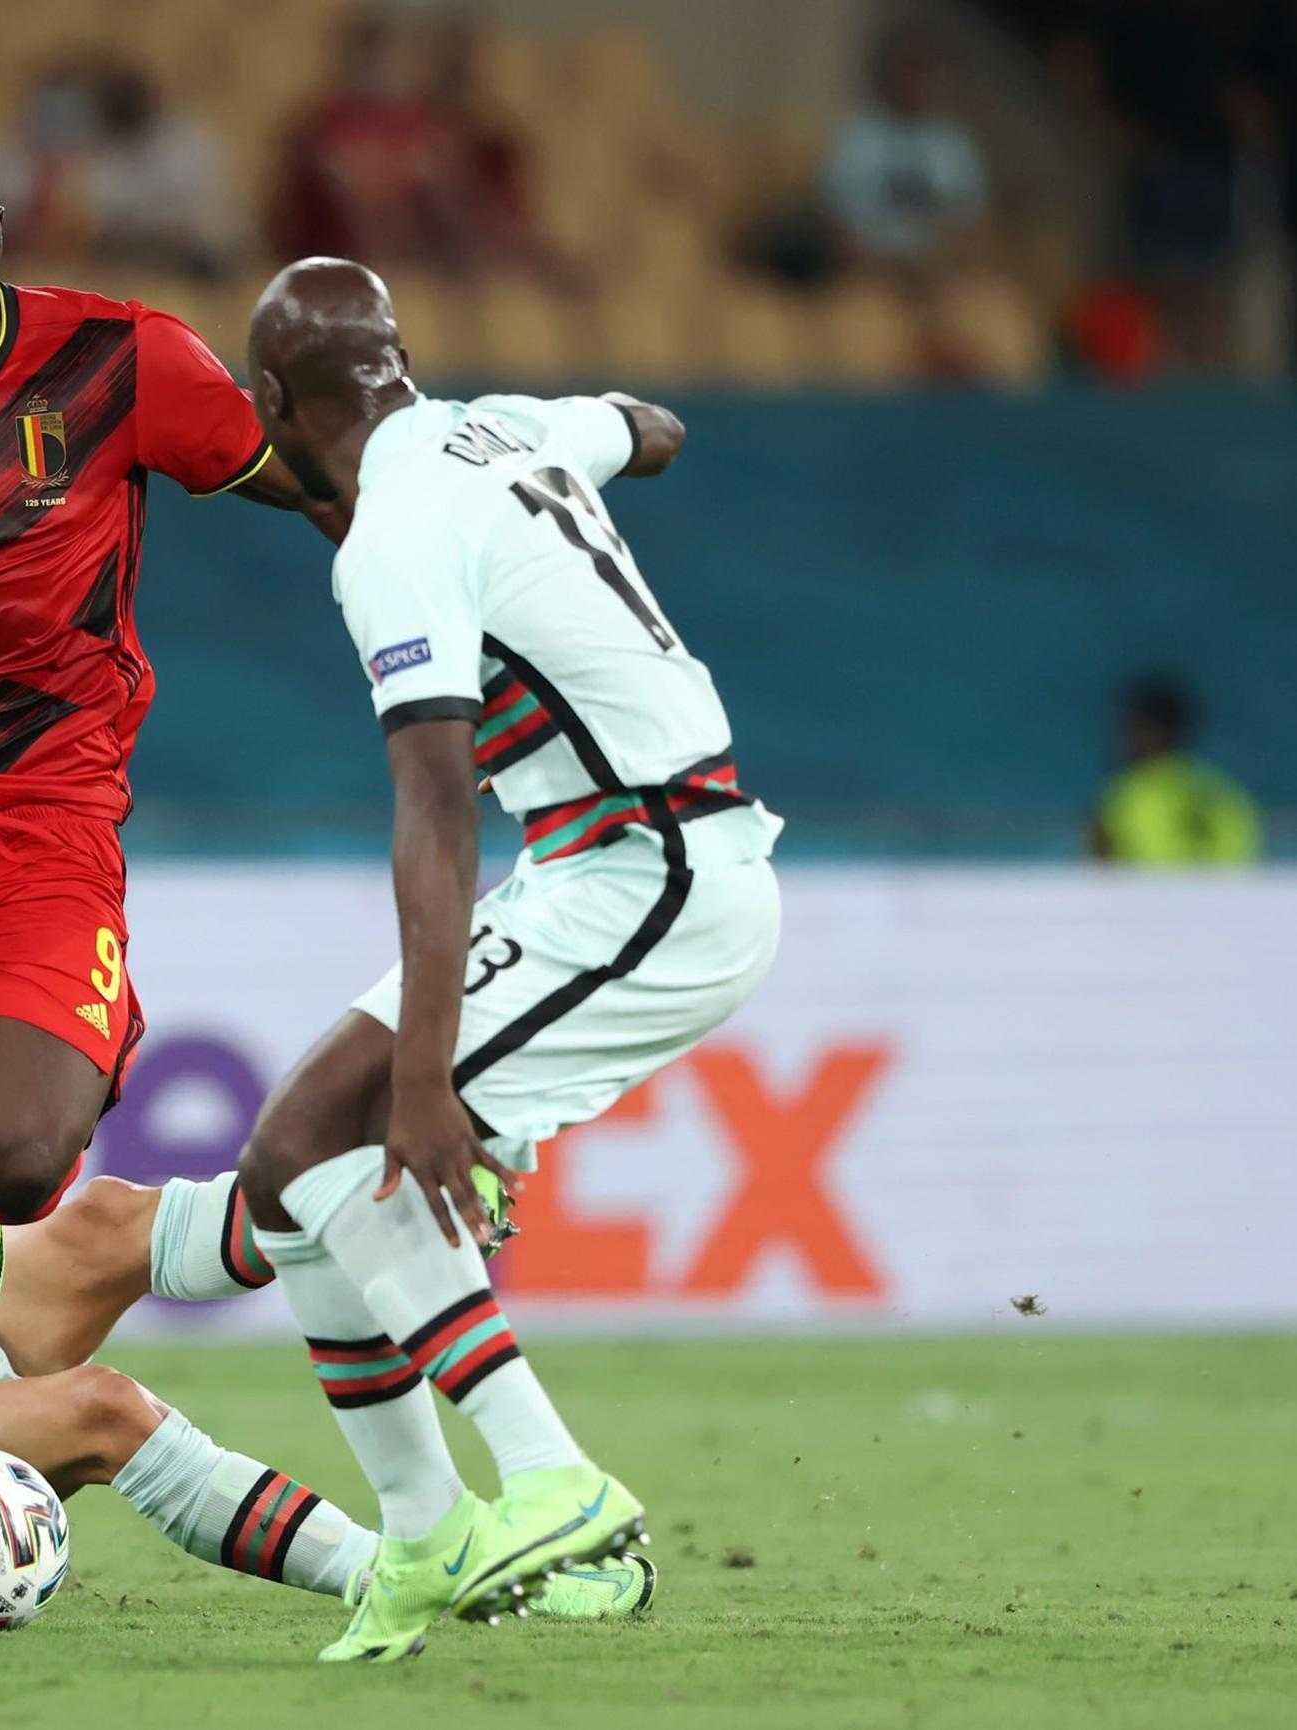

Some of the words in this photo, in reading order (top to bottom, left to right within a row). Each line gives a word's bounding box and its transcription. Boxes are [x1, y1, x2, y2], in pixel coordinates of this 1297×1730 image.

[25, 498, 39, 507] 125
[40, 496, 66, 507] YEARS
[90, 926, 121, 1004] 9
